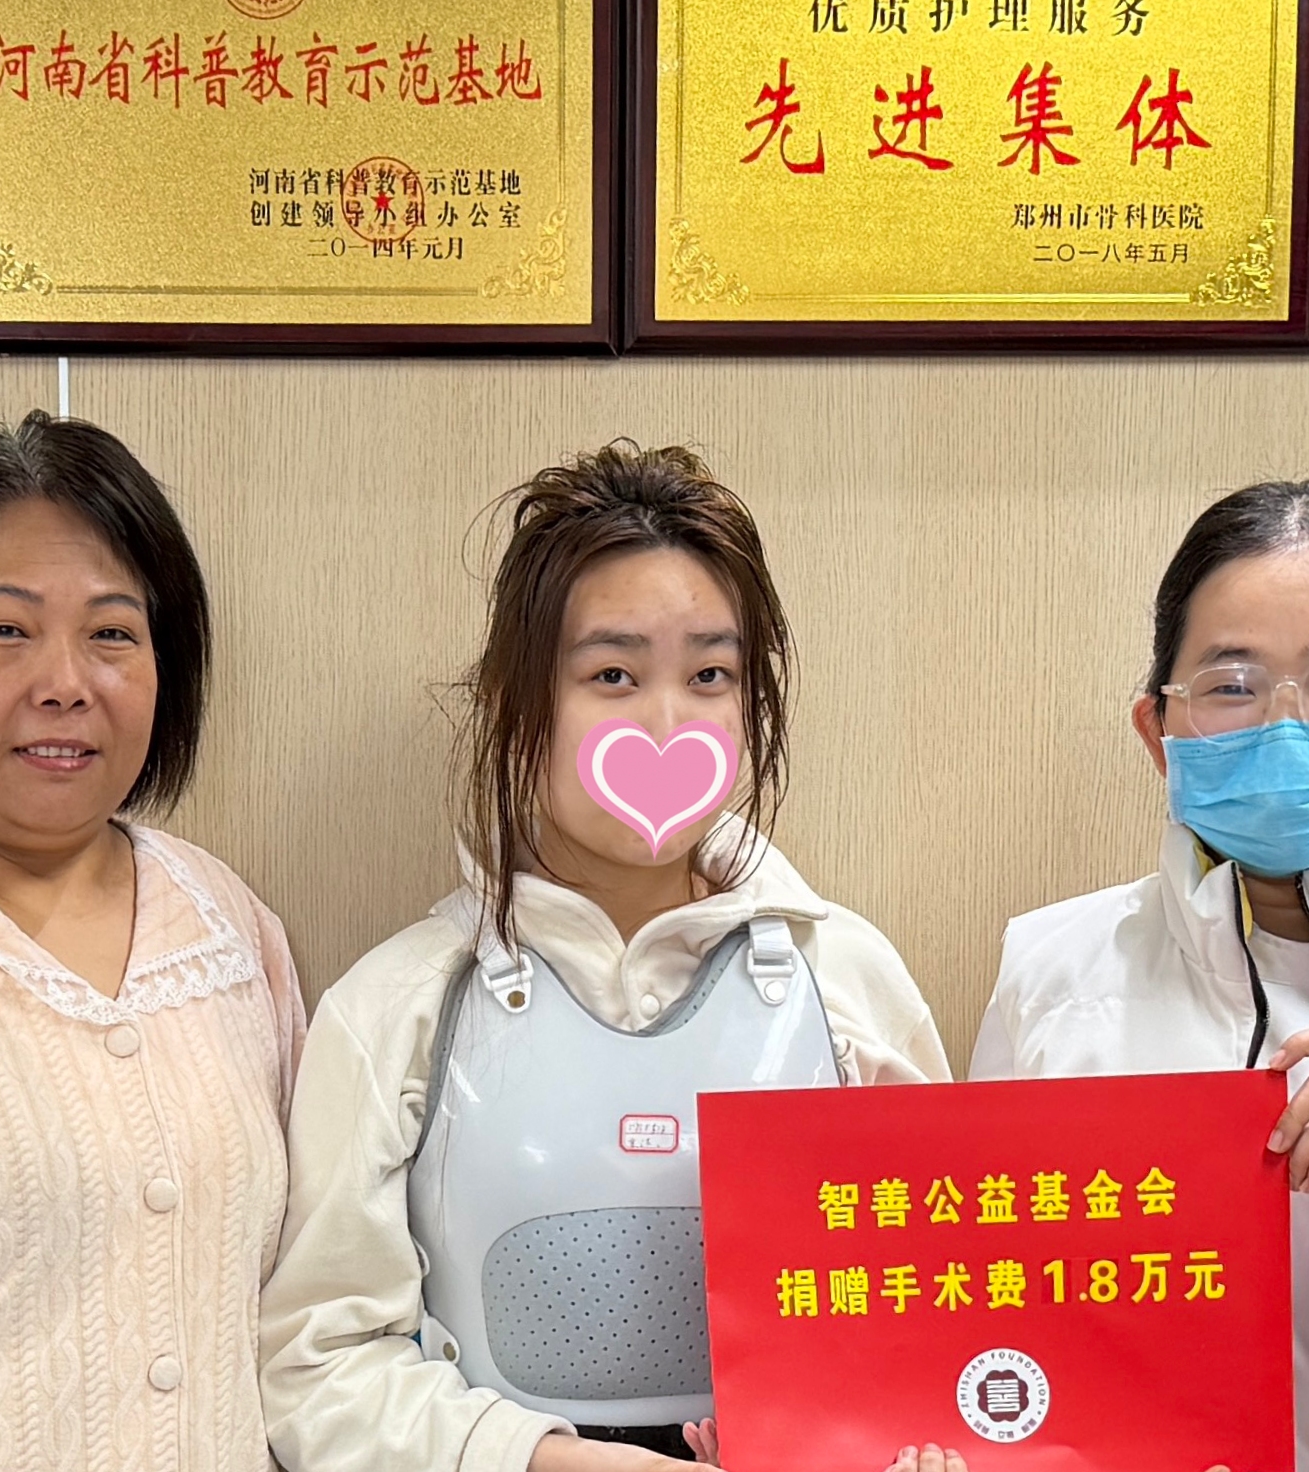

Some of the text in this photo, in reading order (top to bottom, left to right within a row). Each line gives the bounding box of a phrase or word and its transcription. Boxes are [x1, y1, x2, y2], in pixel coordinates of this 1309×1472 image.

[807, 0, 1150, 37] 优质护理服务
[739, 57, 1213, 176] 先进集体
[248, 166, 523, 196] 河南省科普教育示范基地
[248, 200, 523, 231] 创建领导小组办公室
[1012, 201, 1205, 232] 郑州市骨科医院
[818, 1166, 1176, 1231] 智善公益基金会
[775, 1250, 1226, 1318] 捐赠手术费1.8万元
